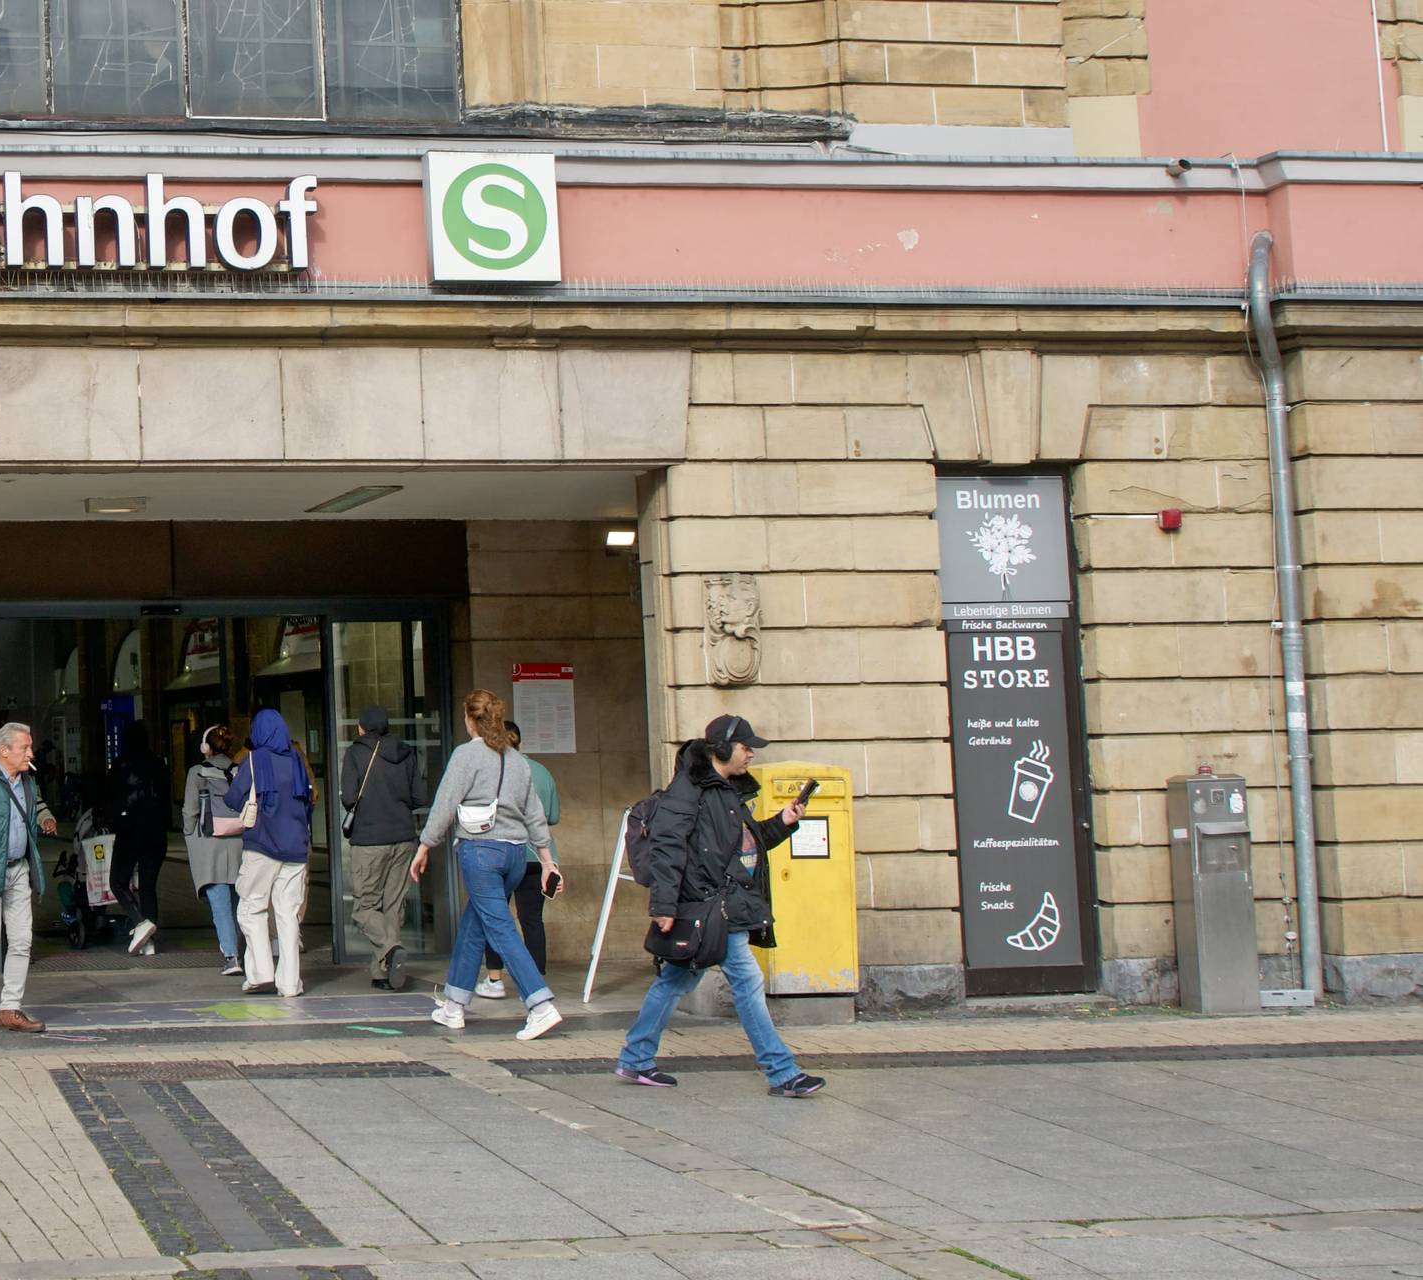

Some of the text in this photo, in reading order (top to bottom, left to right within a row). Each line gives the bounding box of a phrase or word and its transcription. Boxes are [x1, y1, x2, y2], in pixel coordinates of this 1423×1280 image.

[461, 173, 529, 260] S
[956, 489, 1040, 509] Blumen
[953, 604, 1052, 618] Lebendige Blumen
[961, 619, 1048, 630] frische Backwaren
[972, 636, 1037, 662] HBB
[963, 669, 1050, 689] STORE
[967, 718, 1040, 730] heiße und kalte
[968, 735, 1012, 746] Getränke
[973, 837, 1060, 851] Kaffeespezialitäten
[979, 881, 1012, 893] frische
[980, 899, 1015, 911] Snacks
